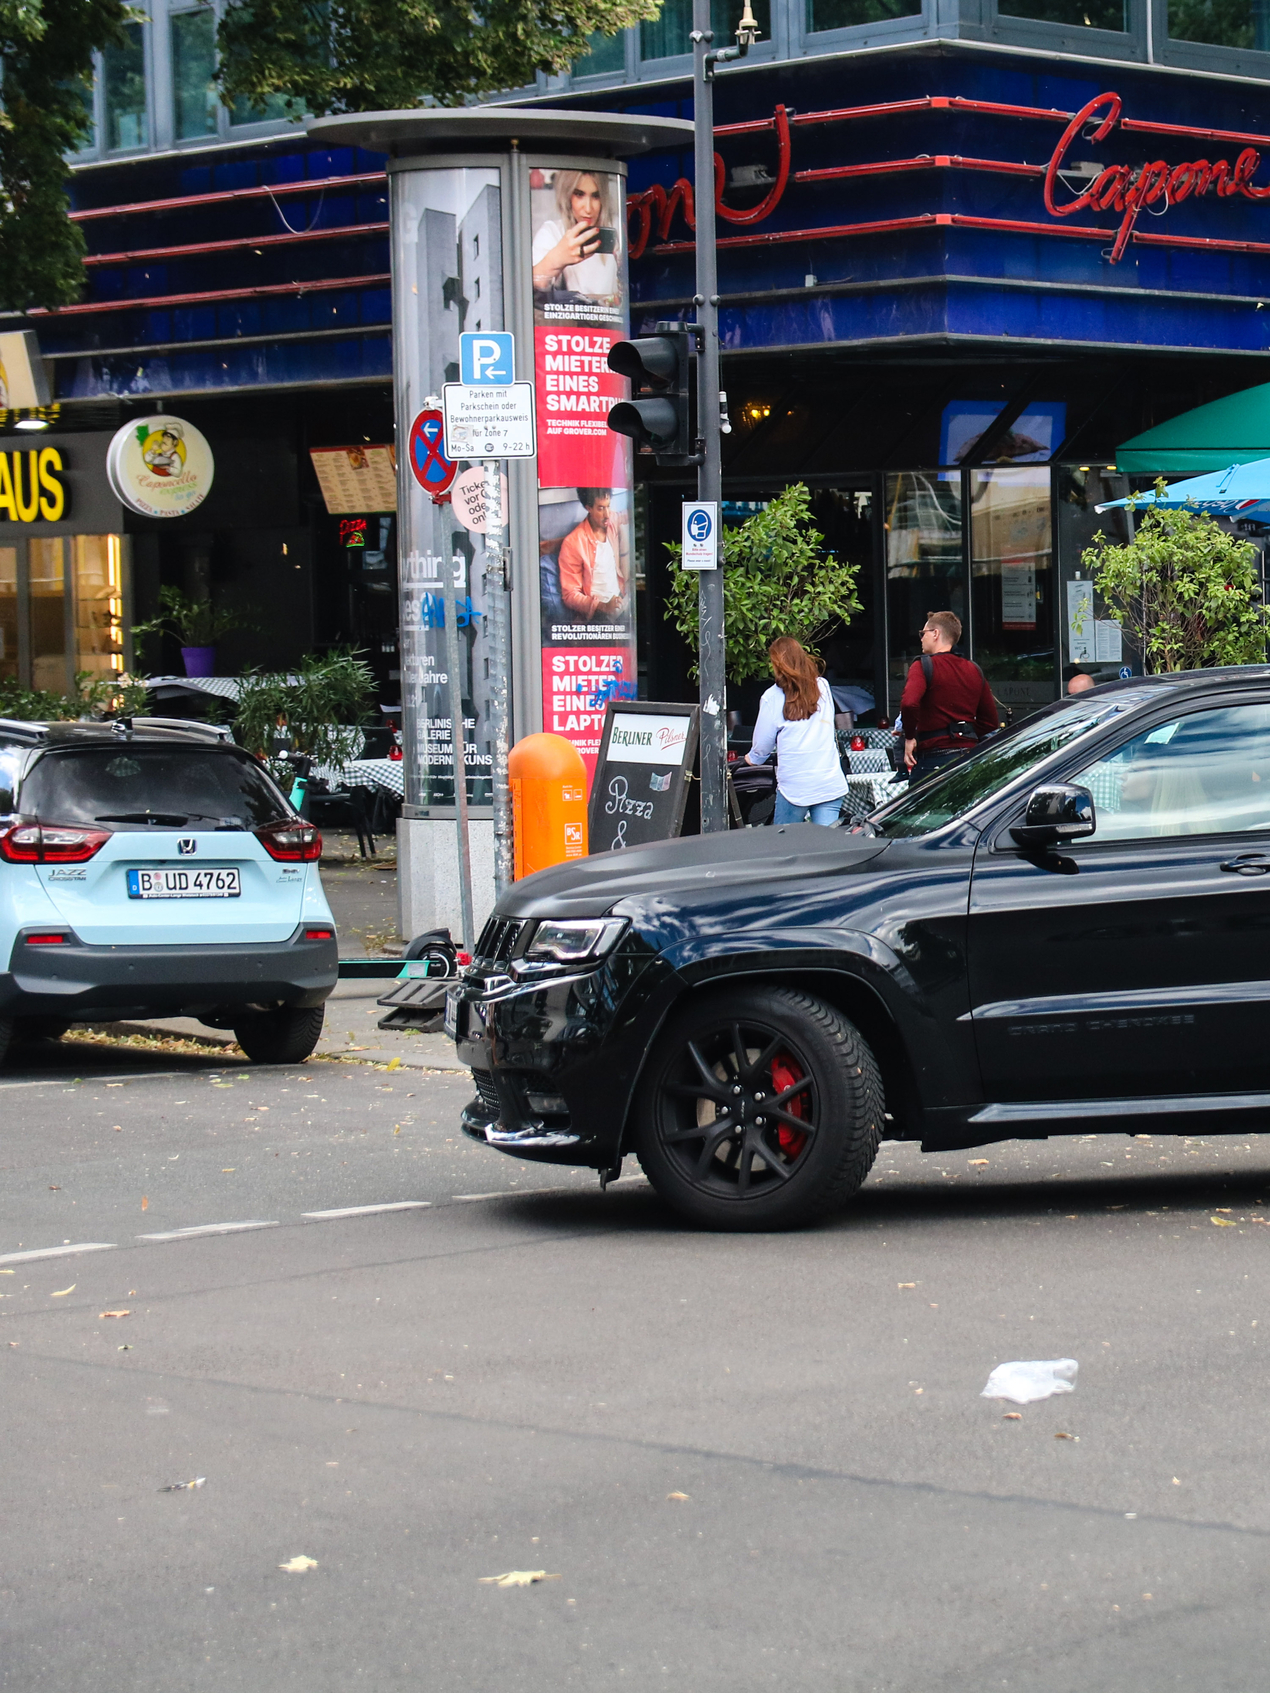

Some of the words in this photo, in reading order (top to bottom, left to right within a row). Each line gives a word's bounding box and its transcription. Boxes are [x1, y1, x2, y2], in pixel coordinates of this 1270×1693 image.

[544, 303, 574, 312] STOLZE
[544, 312, 599, 321] EINZIGARTIGEN
[545, 334, 611, 354] STOLZE
[545, 354, 620, 374] MIETER
[545, 374, 599, 393] EINES
[469, 390, 494, 399] Parken
[495, 390, 508, 398] mit
[460, 403, 500, 411] Parkschein
[501, 402, 517, 410] oder
[450, 413, 529, 426] Bewohnerparkausweis
[546, 419, 580, 427] TECHNIK
[484, 429, 501, 437] Zone
[546, 427, 562, 435] AUF
[563, 427, 607, 436] GROVER.COM
[451, 444, 474, 452] Mo-Sa
[502, 442, 523, 451] 9-22
[525, 442, 531, 451] h
[459, 480, 485, 496] Ticke
[464, 493, 480, 505] vor
[468, 502, 487, 515] ode
[551, 624, 586, 632] STOLZER
[587, 624, 614, 633] BESITZER
[551, 632, 612, 641] REVOLUTIONÄREN
[553, 694, 606, 712] EINES
[417, 718, 476, 729] BERLINISHE
[417, 729, 452, 740] GALERIE
[612, 726, 653, 747] BERLINER
[656, 727, 688, 749] Pilsner
[417, 743, 453, 754] MUSEUM
[462, 741, 477, 754] ÜR
[417, 755, 454, 766] MODERN
[464, 754, 493, 765] KUNS
[605, 776, 654, 819] Pizza
[48, 868, 87, 876] JAZZ
[141, 872, 153, 891] B
[165, 872, 189, 891] UD
[193, 871, 237, 891] 4762
[1086, 1014, 1195, 1030] CHEROKEE
